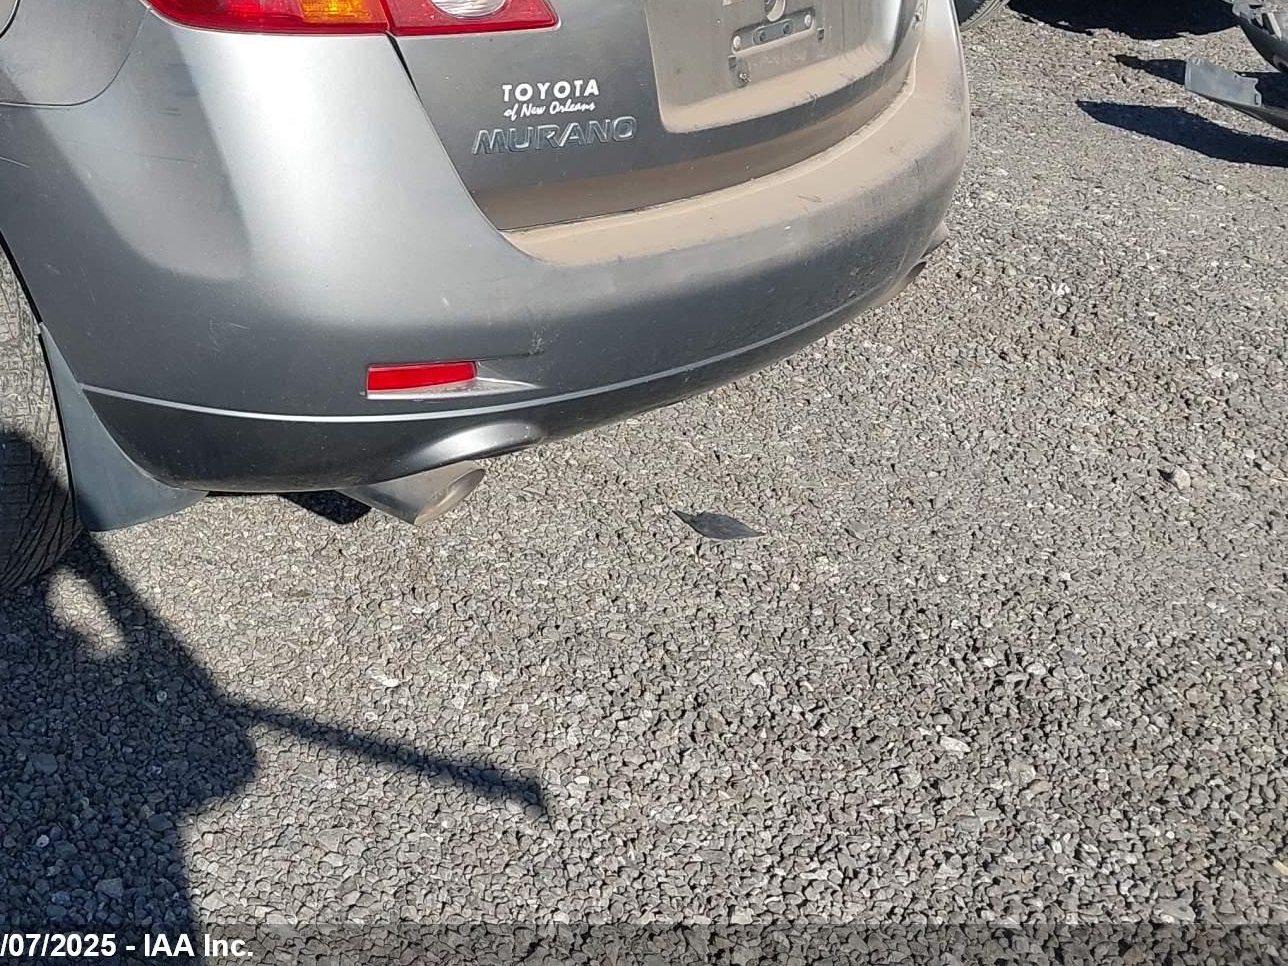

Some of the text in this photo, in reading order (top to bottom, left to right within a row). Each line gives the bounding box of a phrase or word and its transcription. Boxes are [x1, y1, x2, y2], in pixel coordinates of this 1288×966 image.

[502, 79, 599, 102] TOYOTA
[503, 99, 596, 121] of New Orleans
[472, 116, 637, 155] MURANO
